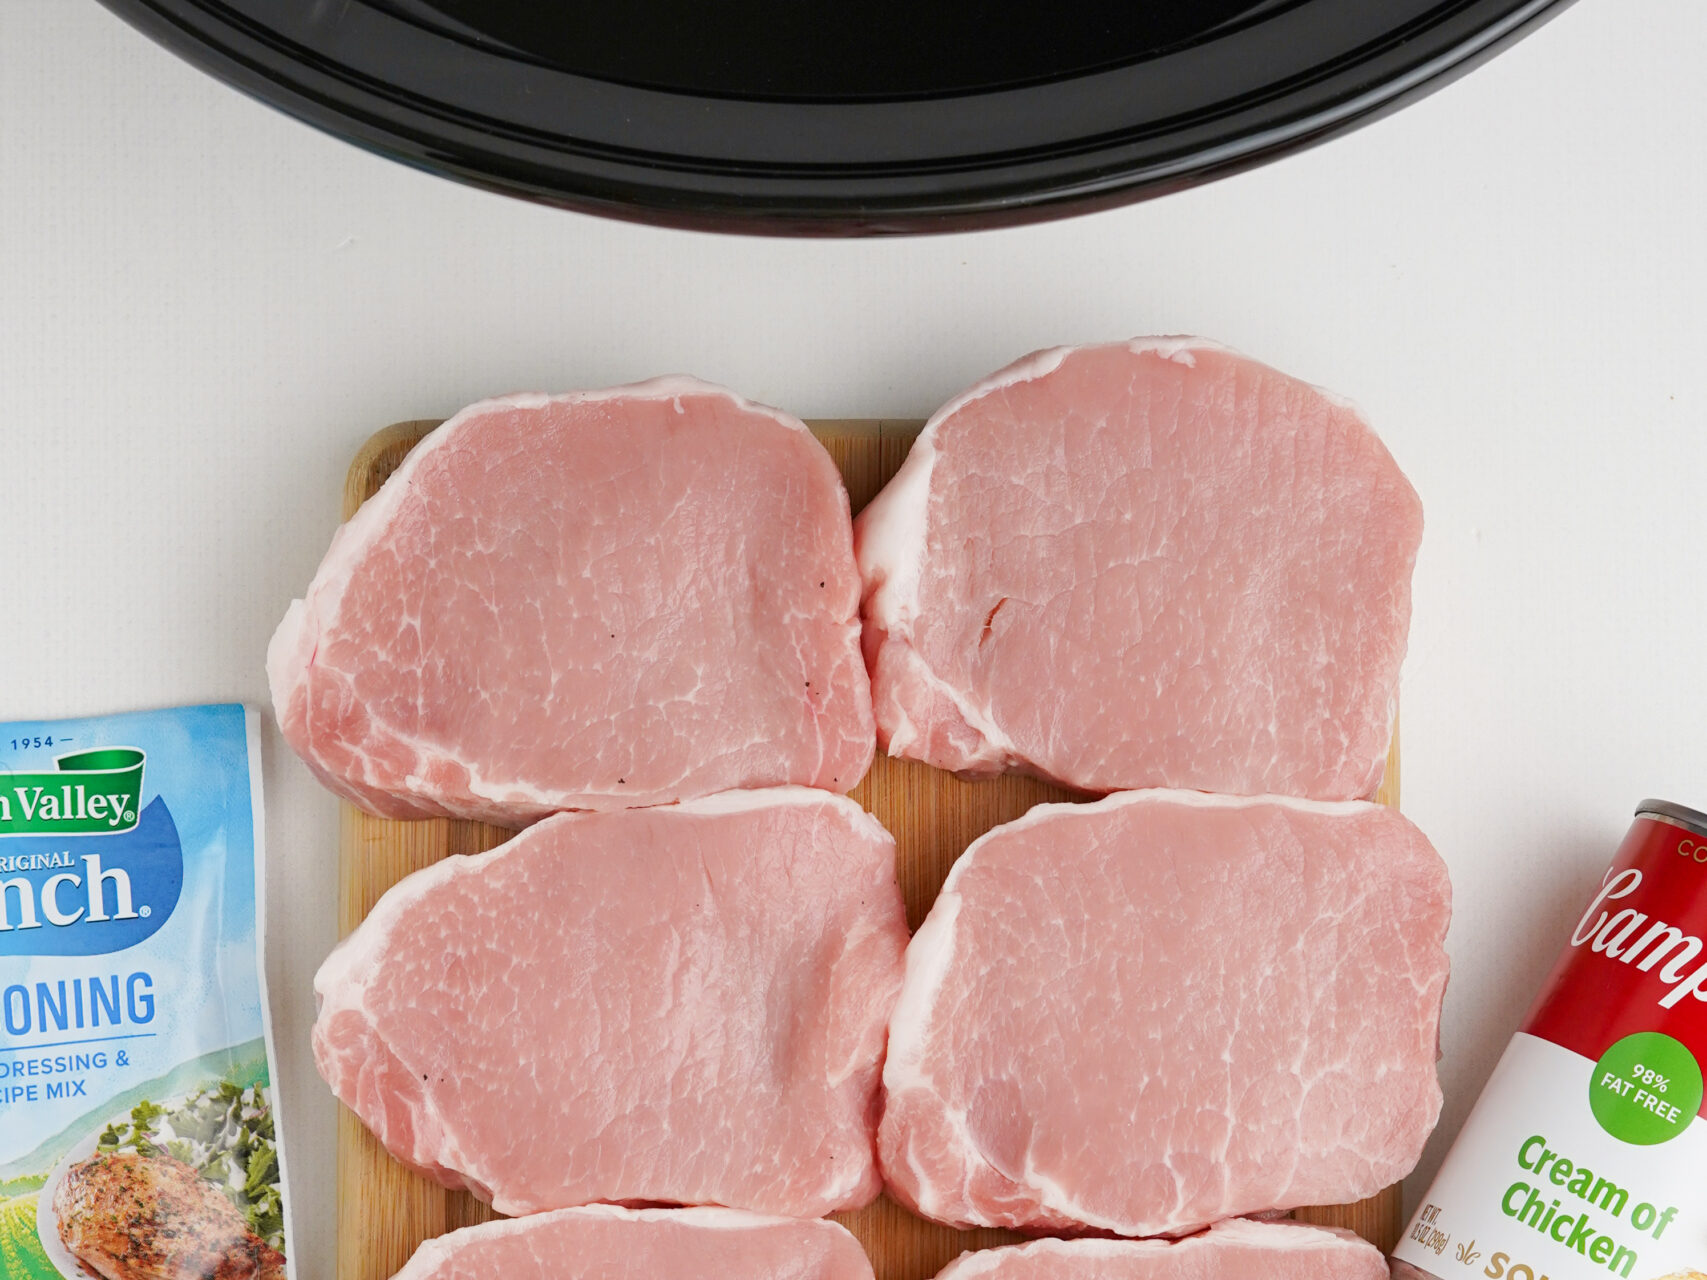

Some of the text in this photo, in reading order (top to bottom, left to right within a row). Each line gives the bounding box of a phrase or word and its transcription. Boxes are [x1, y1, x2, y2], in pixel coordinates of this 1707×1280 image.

[11, 735, 54, 751] 1954
[3, 971, 155, 1036] ONING
[115, 1049, 130, 1067] &
[1631, 1063, 1671, 1094] 98%
[0, 1079, 87, 1104] IPE MIX
[1600, 1072, 1682, 1125] FAT FREE
[1517, 1135, 1679, 1241] Cream of
[1501, 1181, 1639, 1280] Chicken
